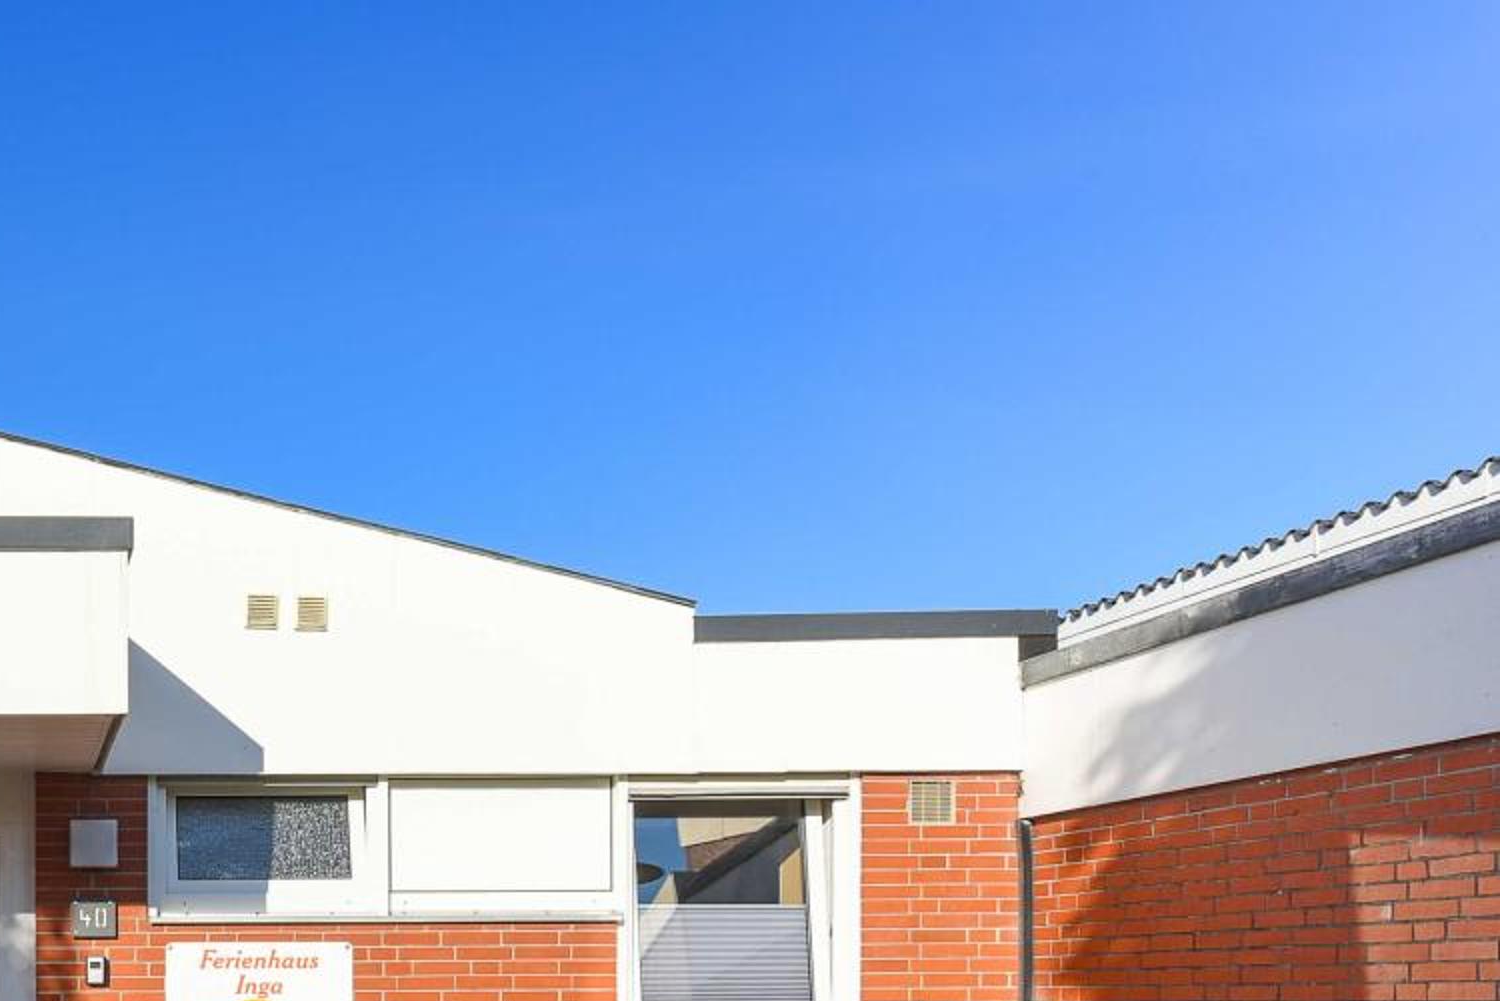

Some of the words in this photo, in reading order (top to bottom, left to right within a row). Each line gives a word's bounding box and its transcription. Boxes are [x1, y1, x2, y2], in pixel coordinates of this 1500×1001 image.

[79, 908, 108, 928] 40
[199, 949, 319, 970] Ferienhaus
[235, 974, 283, 998] Inga
